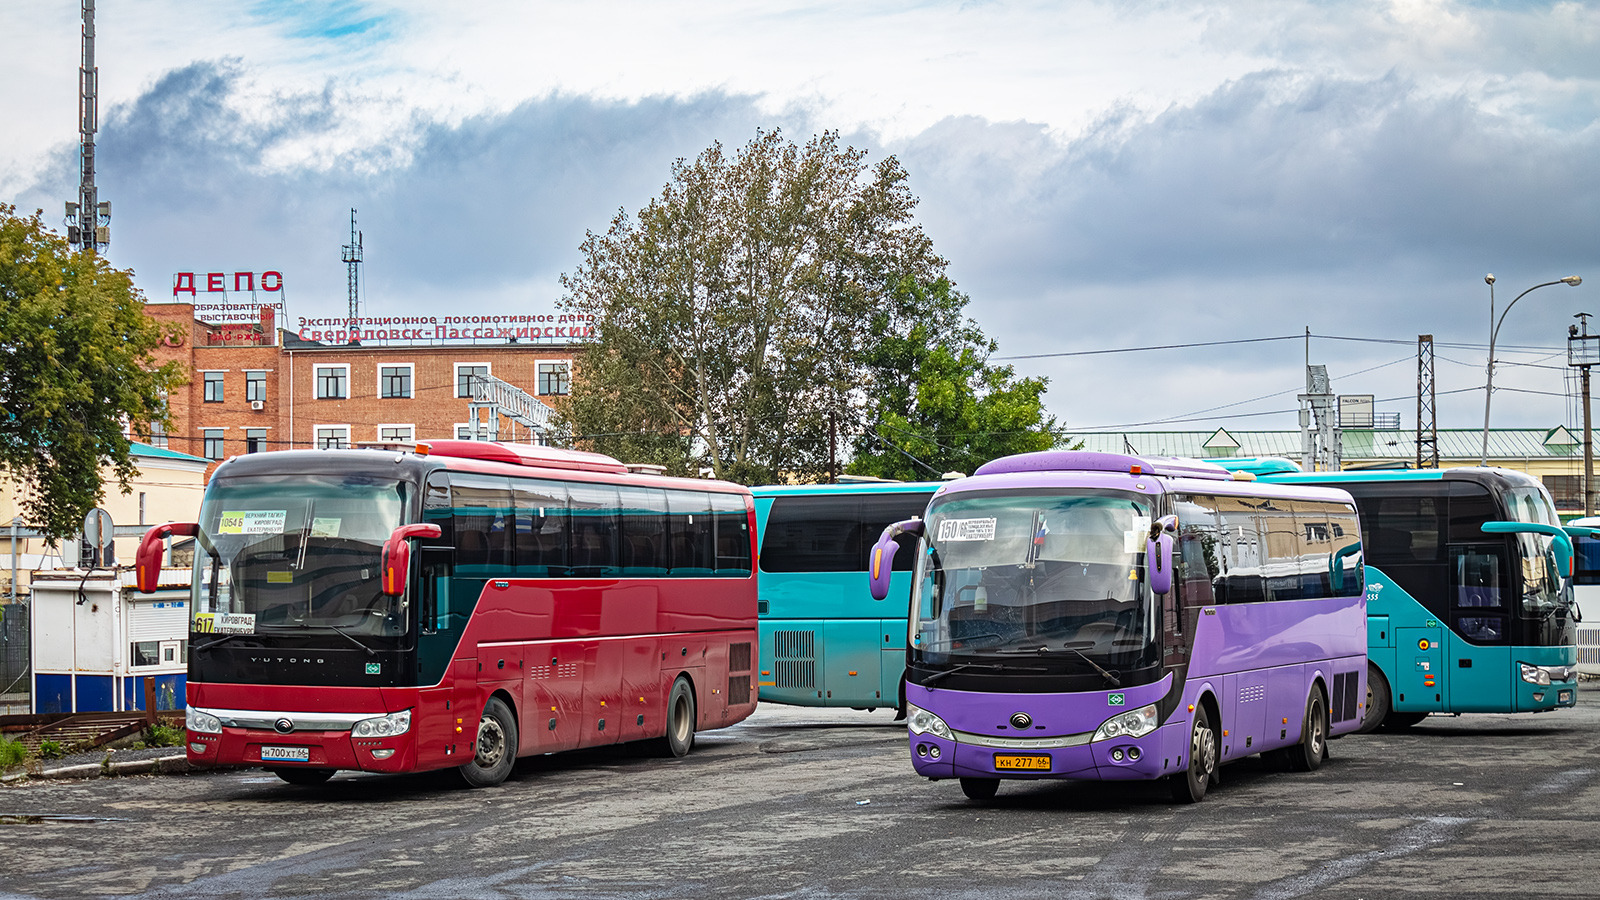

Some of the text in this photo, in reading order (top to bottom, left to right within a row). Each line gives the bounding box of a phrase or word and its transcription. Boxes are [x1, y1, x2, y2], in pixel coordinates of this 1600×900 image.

[173, 271, 282, 296] ДЕПО
[200, 313, 274, 321] ВЫСТАВОЧНЫЙ
[298, 314, 595, 328] Эксплуатационное локомотивное депо
[221, 519, 237, 527] 1054
[196, 617, 214, 633] 617
[1015, 758, 1032, 767] 277
